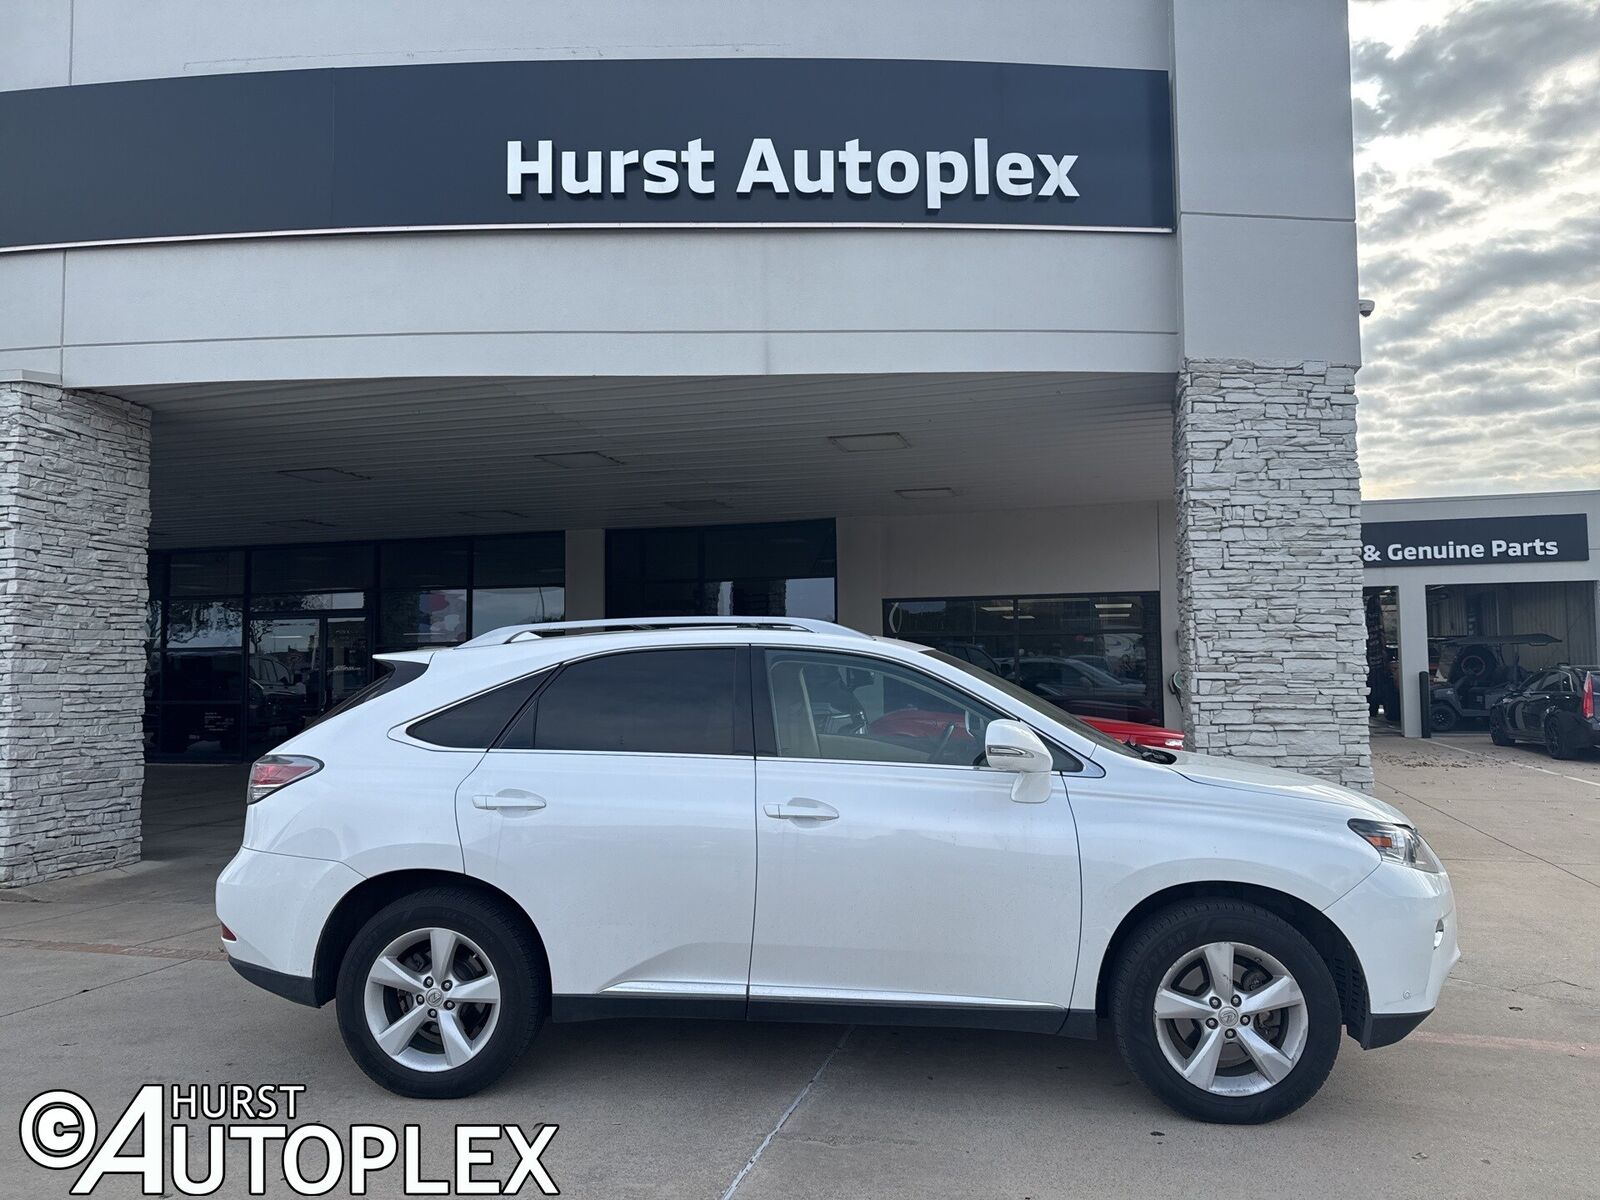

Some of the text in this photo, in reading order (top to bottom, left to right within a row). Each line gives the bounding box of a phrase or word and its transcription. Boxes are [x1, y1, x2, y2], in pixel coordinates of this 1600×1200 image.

[506, 138, 1080, 210] Hurst Autoplex
[1363, 538, 1559, 561] & Genuine Parts
